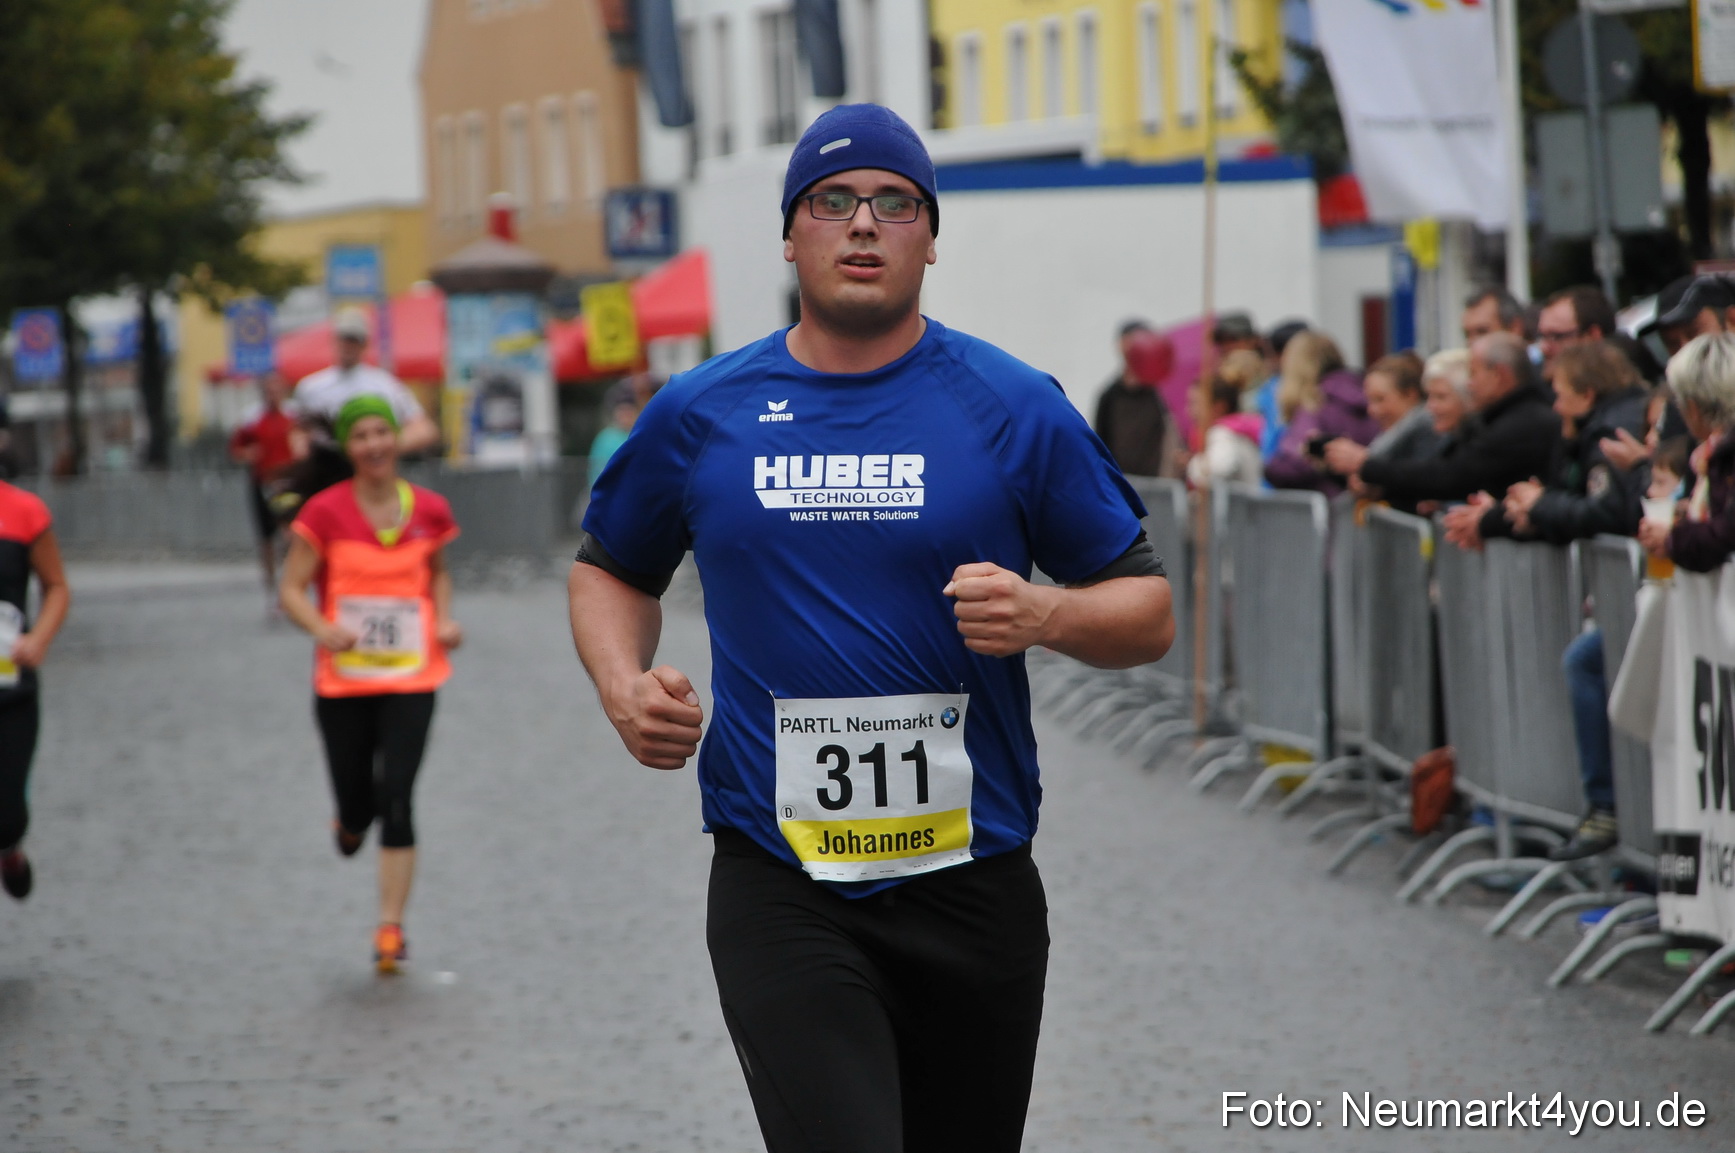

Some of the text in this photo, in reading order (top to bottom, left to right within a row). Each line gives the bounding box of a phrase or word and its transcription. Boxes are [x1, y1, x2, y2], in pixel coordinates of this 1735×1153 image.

[758, 412, 794, 422] erima
[753, 454, 925, 489] HUBER
[790, 491, 917, 504] TECHNOLOGY
[790, 510, 919, 521] WASTE WATER Solutions
[780, 717, 841, 734] PARTL
[846, 713, 934, 733] Neumarkt
[816, 740, 929, 811] 311
[817, 827, 935, 855] Johannes
